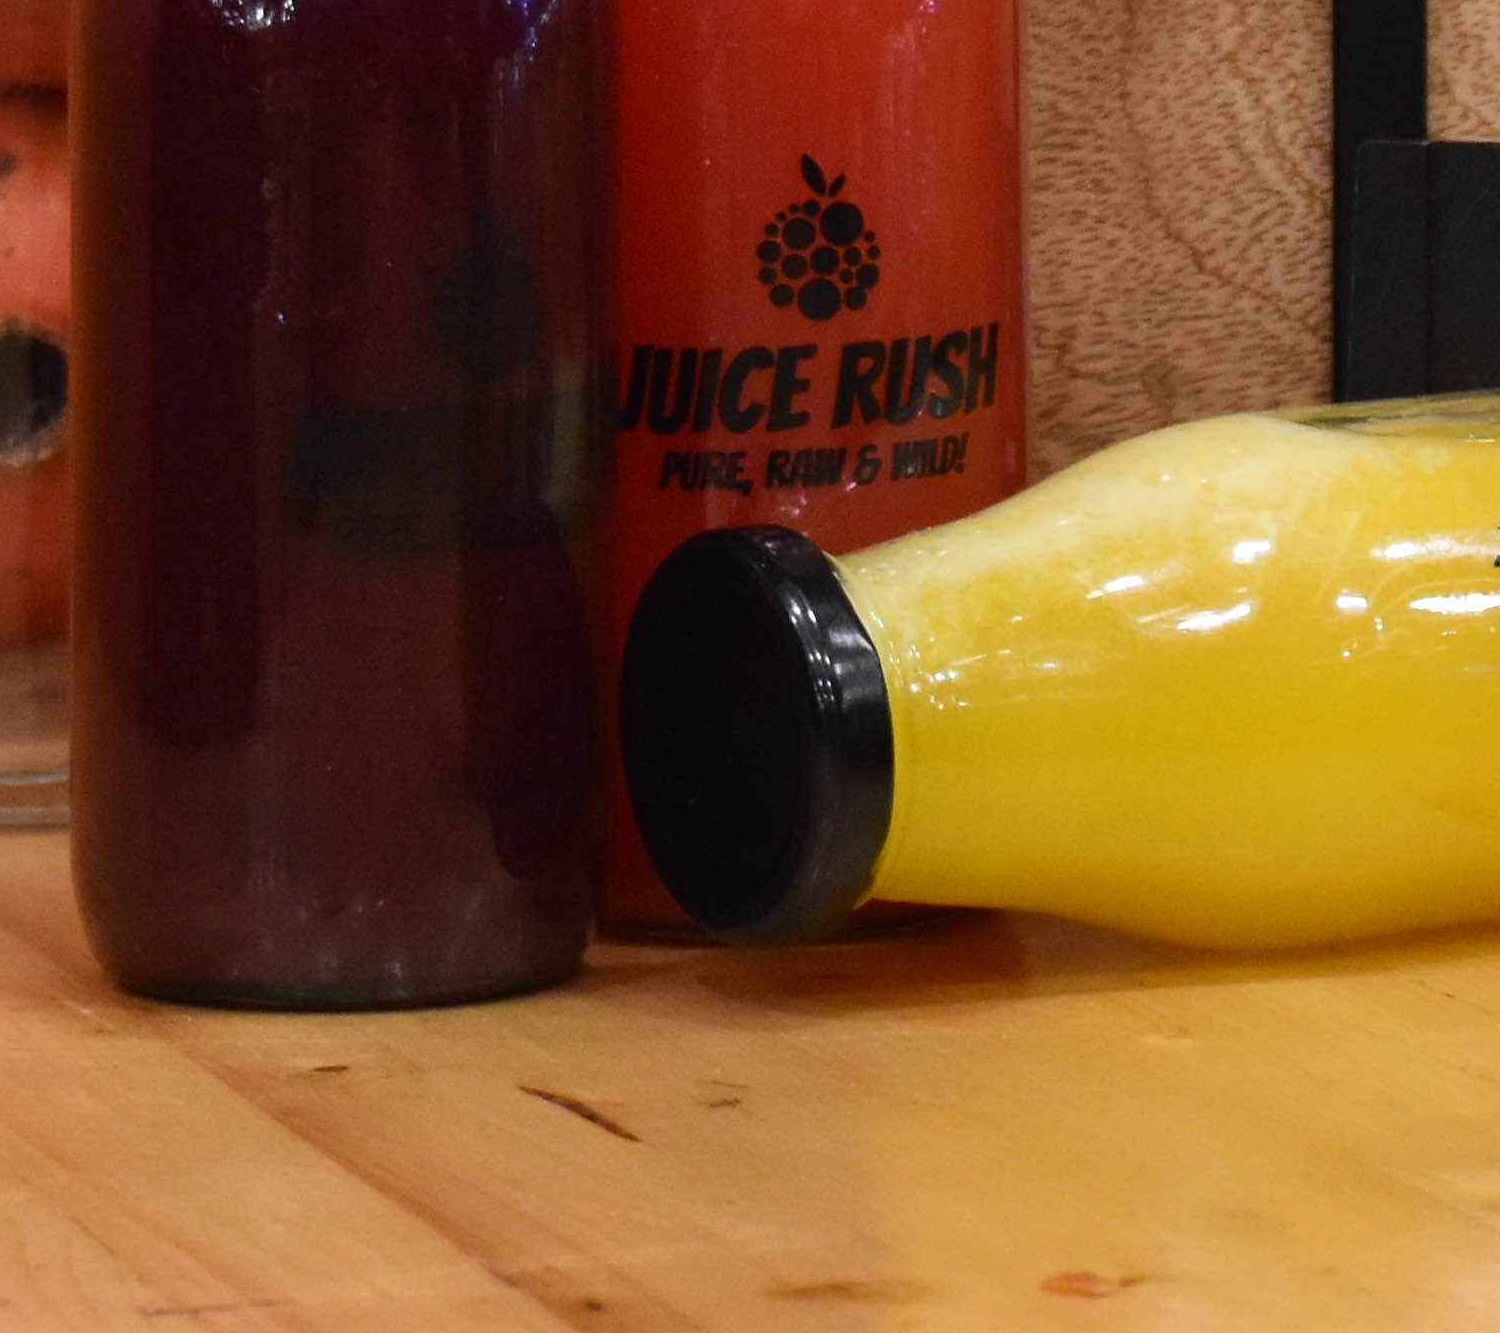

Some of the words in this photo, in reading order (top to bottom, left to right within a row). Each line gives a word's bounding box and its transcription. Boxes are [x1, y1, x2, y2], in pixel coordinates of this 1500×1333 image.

[617, 343, 818, 434] JUICE
[832, 322, 998, 429] RUSH
[659, 450, 753, 496] PURE,
[766, 445, 847, 488] RAW
[853, 444, 883, 485] &
[892, 432, 970, 480] WILD!
